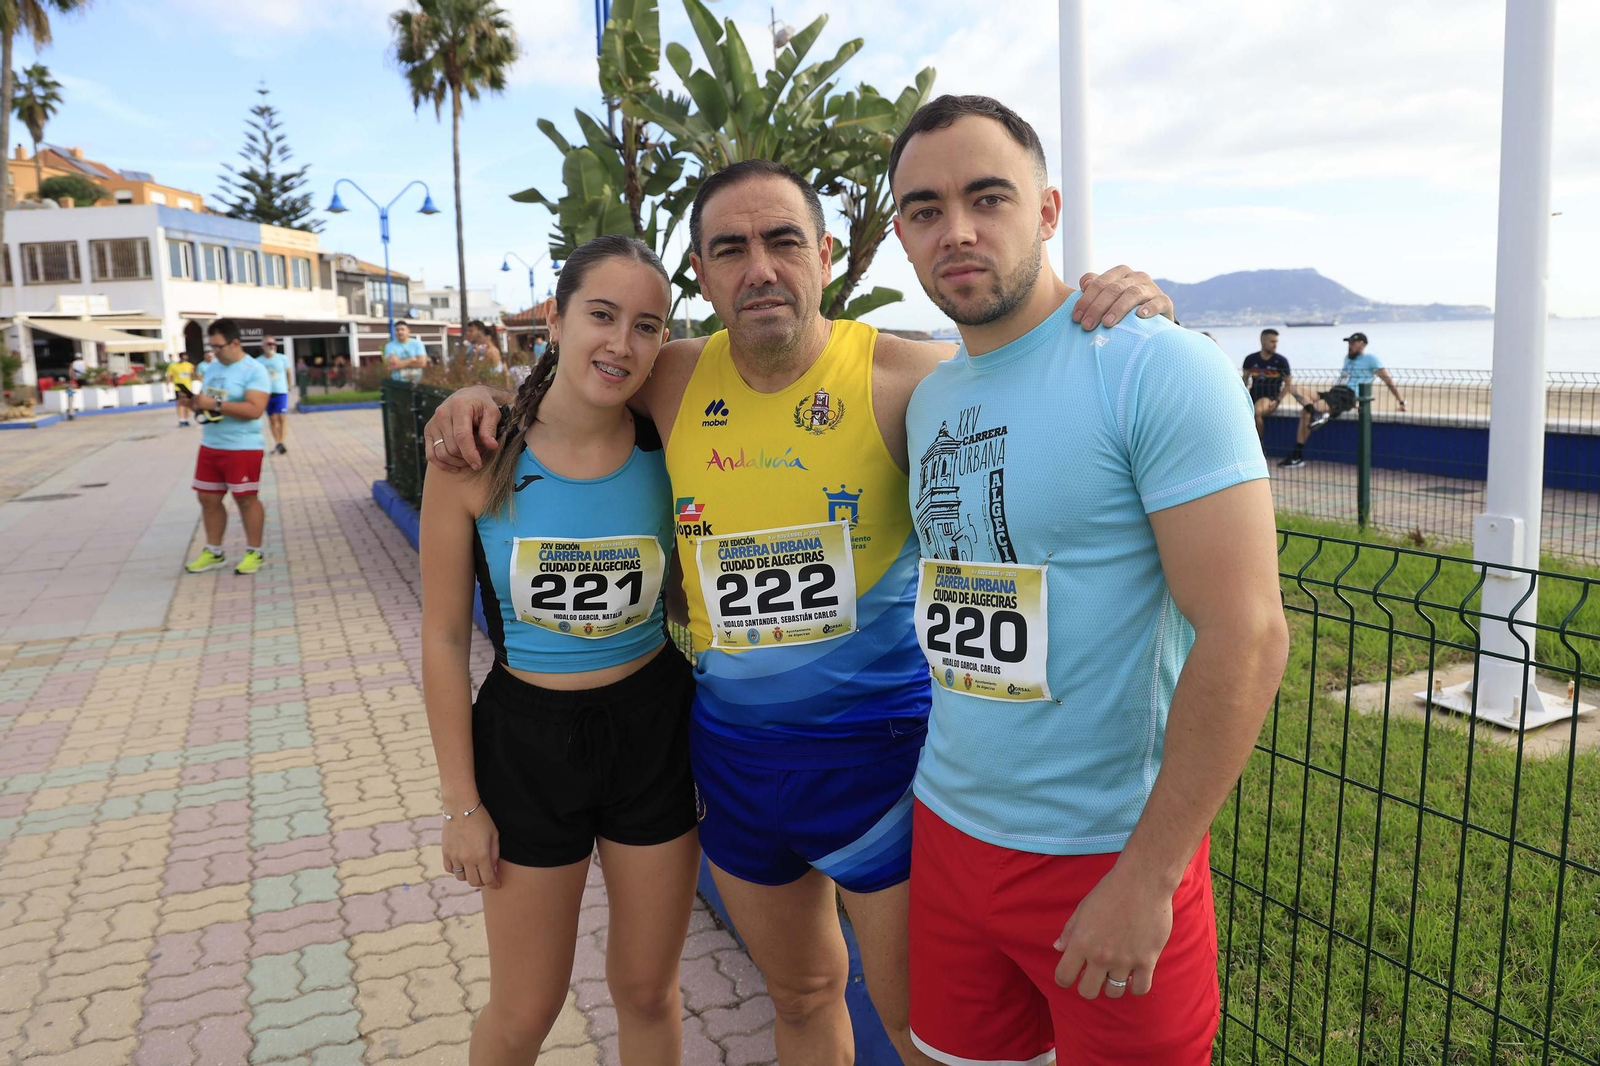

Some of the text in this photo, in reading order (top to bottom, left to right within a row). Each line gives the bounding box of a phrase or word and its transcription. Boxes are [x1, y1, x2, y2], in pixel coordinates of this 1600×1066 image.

[702, 418, 728, 427] mobel
[956, 404, 982, 438] XXV
[962, 425, 1008, 446] CARRERA
[706, 447, 809, 472] Andalucía
[958, 437, 1005, 476] URBANA
[990, 472, 1015, 564] ALGECI
[540, 541, 580, 551] XXV EDICIÓN
[718, 537, 823, 560] CARRERA URBANA
[719, 537, 756, 548] XXV EDICIÓN
[538, 547, 640, 562] CARRERA URBANA
[720, 550, 825, 573] CIUDAD DE ALGECIRAS
[539, 559, 641, 573] CIUDAD DE ALGECIRAS
[936, 565, 962, 575] XXV EDICIÓN
[531, 570, 643, 611] 221
[716, 563, 839, 617] 222
[935, 573, 1017, 594] CARRERA URBANA
[933, 588, 1018, 609] CIUDAD DE ALGECIRAS
[553, 613, 577, 621] HIDALGO
[578, 613, 601, 621] GARCIA,
[602, 610, 623, 620] NATALIA
[723, 618, 744, 628] HIDALGO
[745, 617, 780, 628] SANTANDER,
[781, 612, 813, 623] SEBASTIÁN
[814, 610, 837, 619] CARLOS
[926, 602, 1028, 663] 220
[942, 657, 1001, 675] HIDALGO GARCIA, CARLOS
